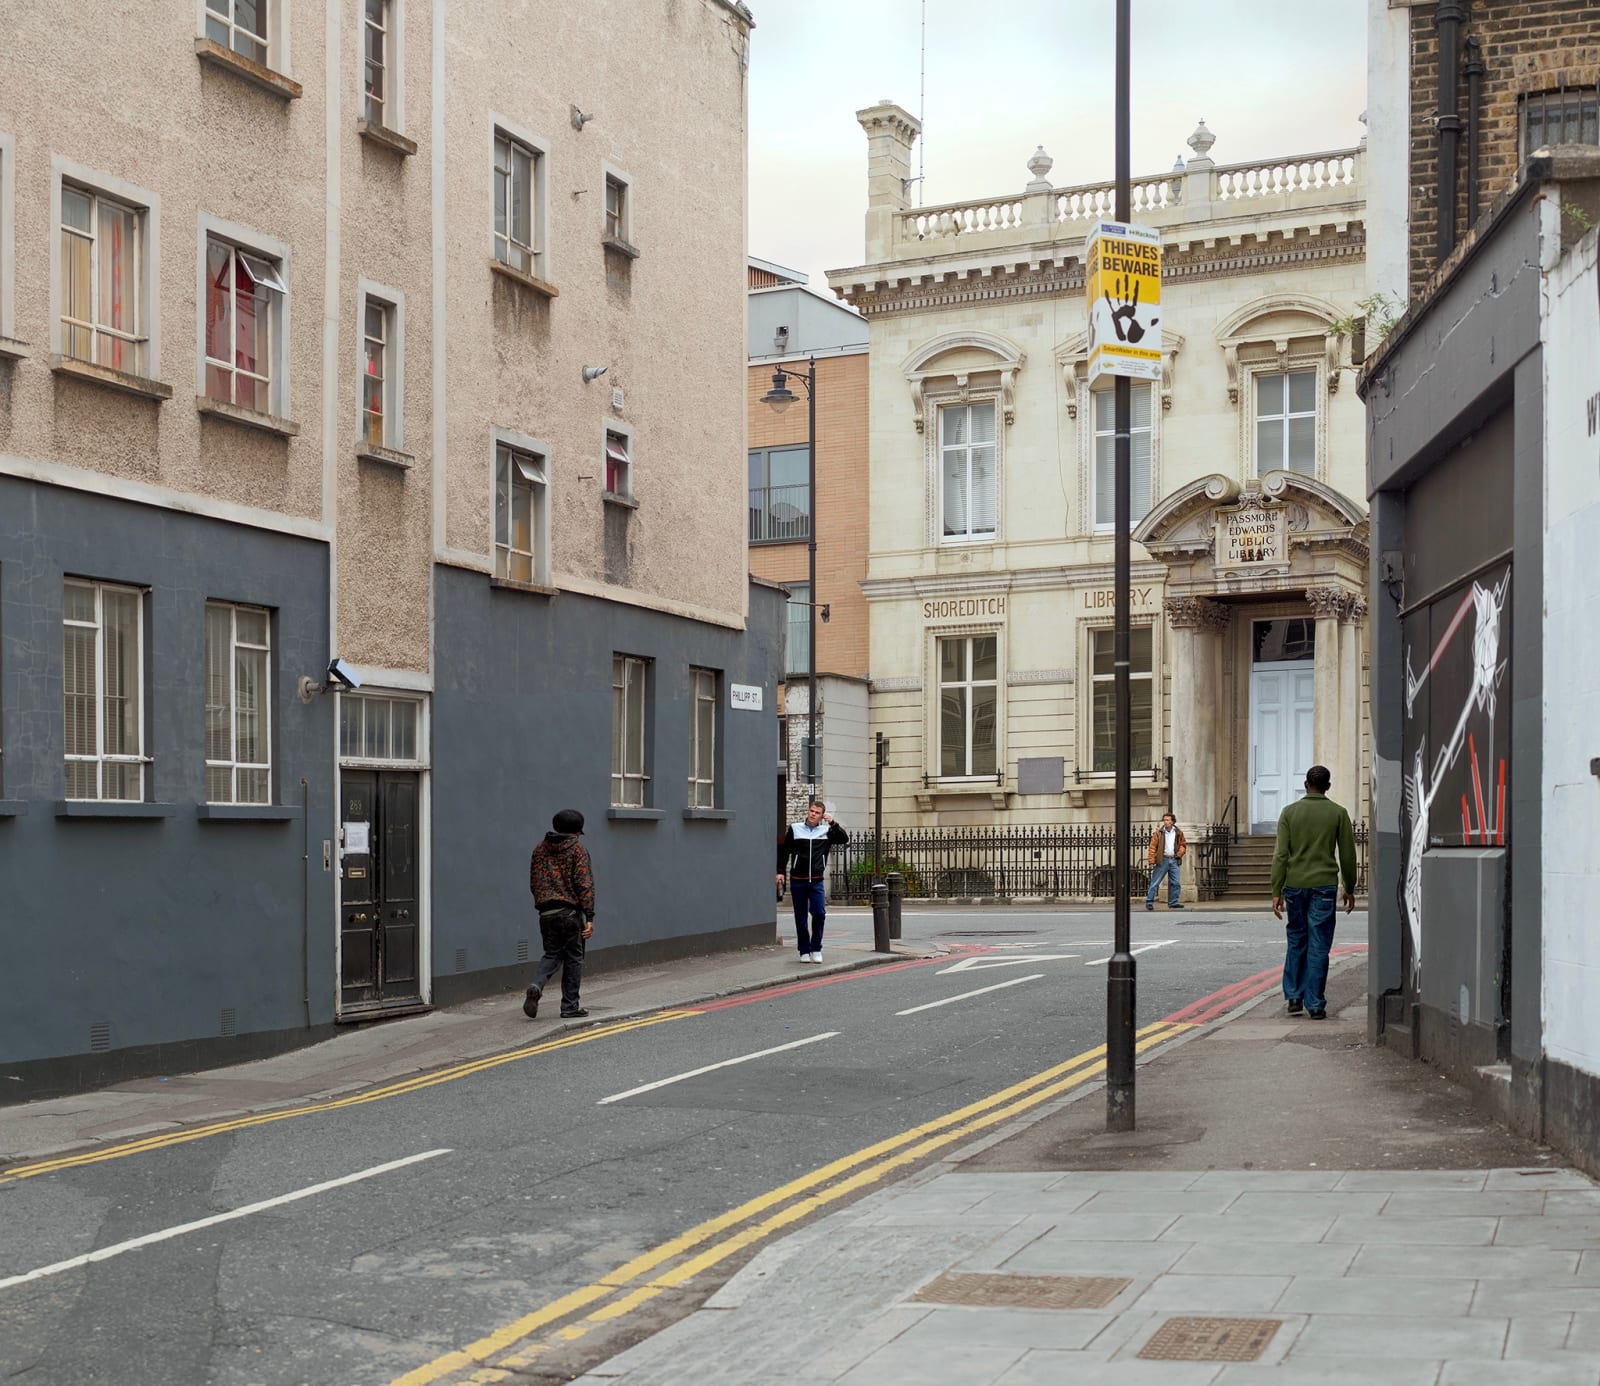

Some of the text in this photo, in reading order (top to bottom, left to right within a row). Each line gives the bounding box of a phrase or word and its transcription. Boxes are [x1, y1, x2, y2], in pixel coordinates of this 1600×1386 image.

[1102, 239, 1158, 261] THIEVES
[1102, 256, 1159, 278] BEWARE
[1227, 512, 1278, 525] PASSMORE
[1229, 524, 1275, 536] EDWARDS
[1232, 536, 1273, 547] PUBLIC
[1229, 547, 1277, 560] LIBRARY
[924, 597, 1005, 618] SHOREDITCH
